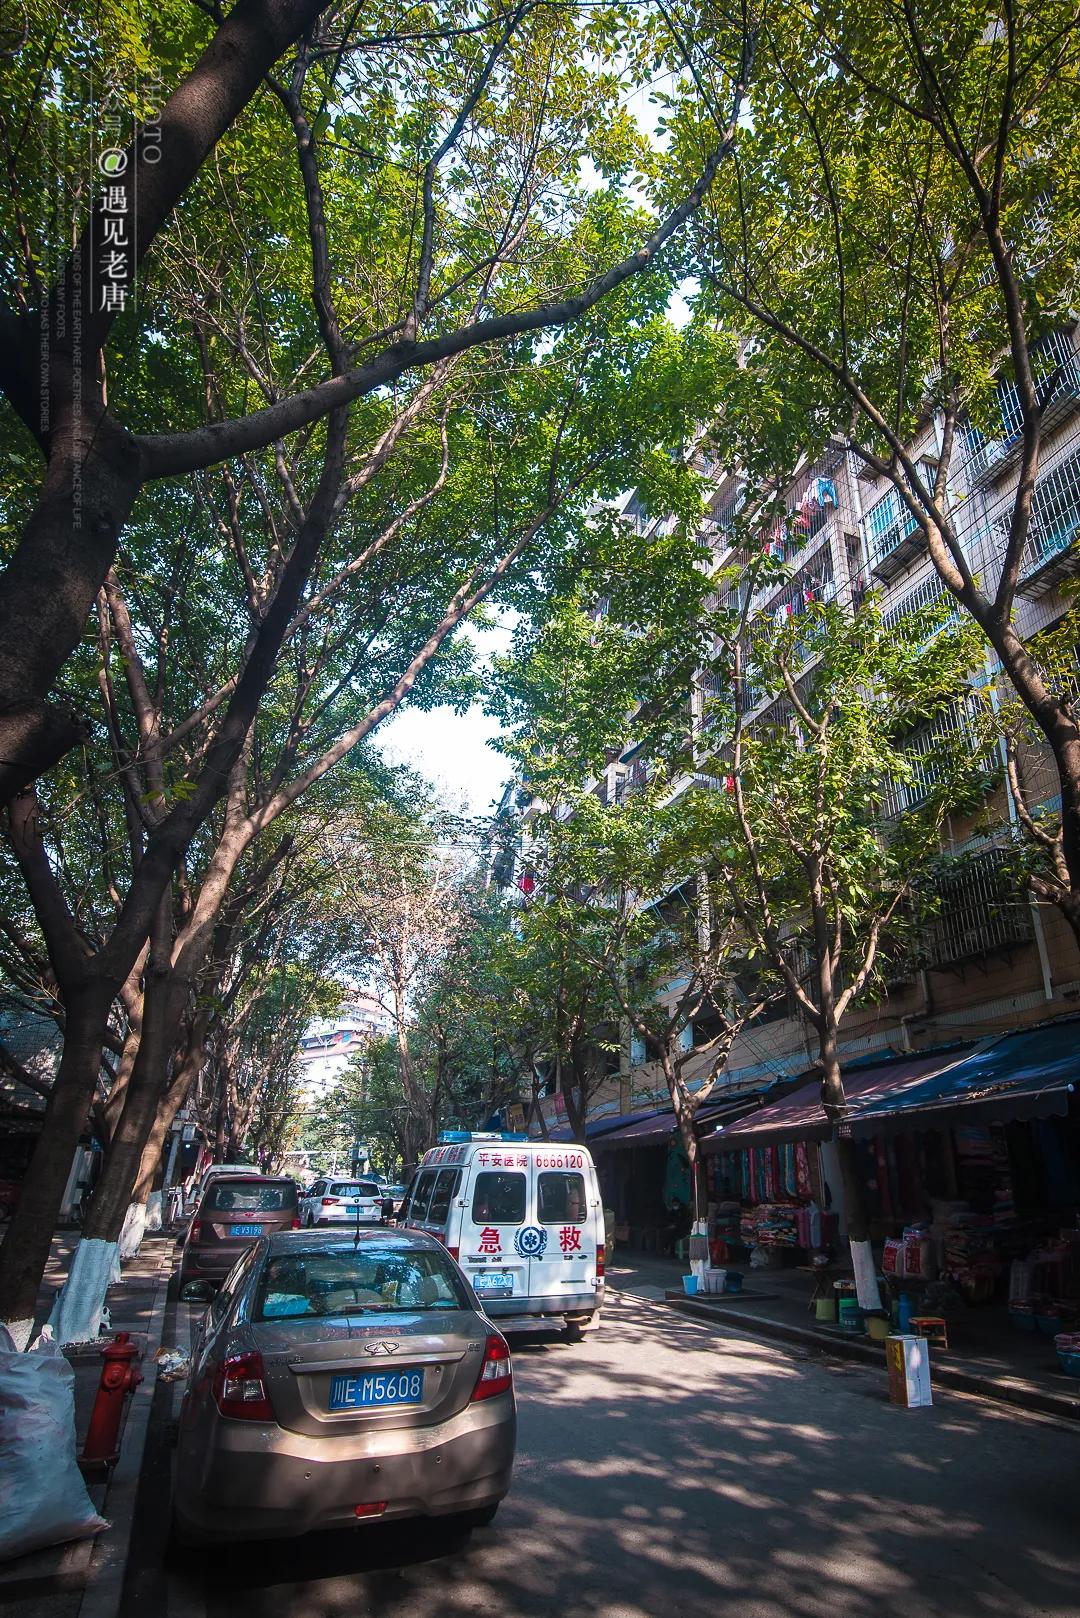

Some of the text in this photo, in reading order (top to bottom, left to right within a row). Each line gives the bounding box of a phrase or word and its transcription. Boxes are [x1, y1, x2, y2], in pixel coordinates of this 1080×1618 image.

[479, 1153, 528, 1168] 平安医院
[536, 1154, 584, 1169] 6666120
[477, 1226, 583, 1254] 急 救
